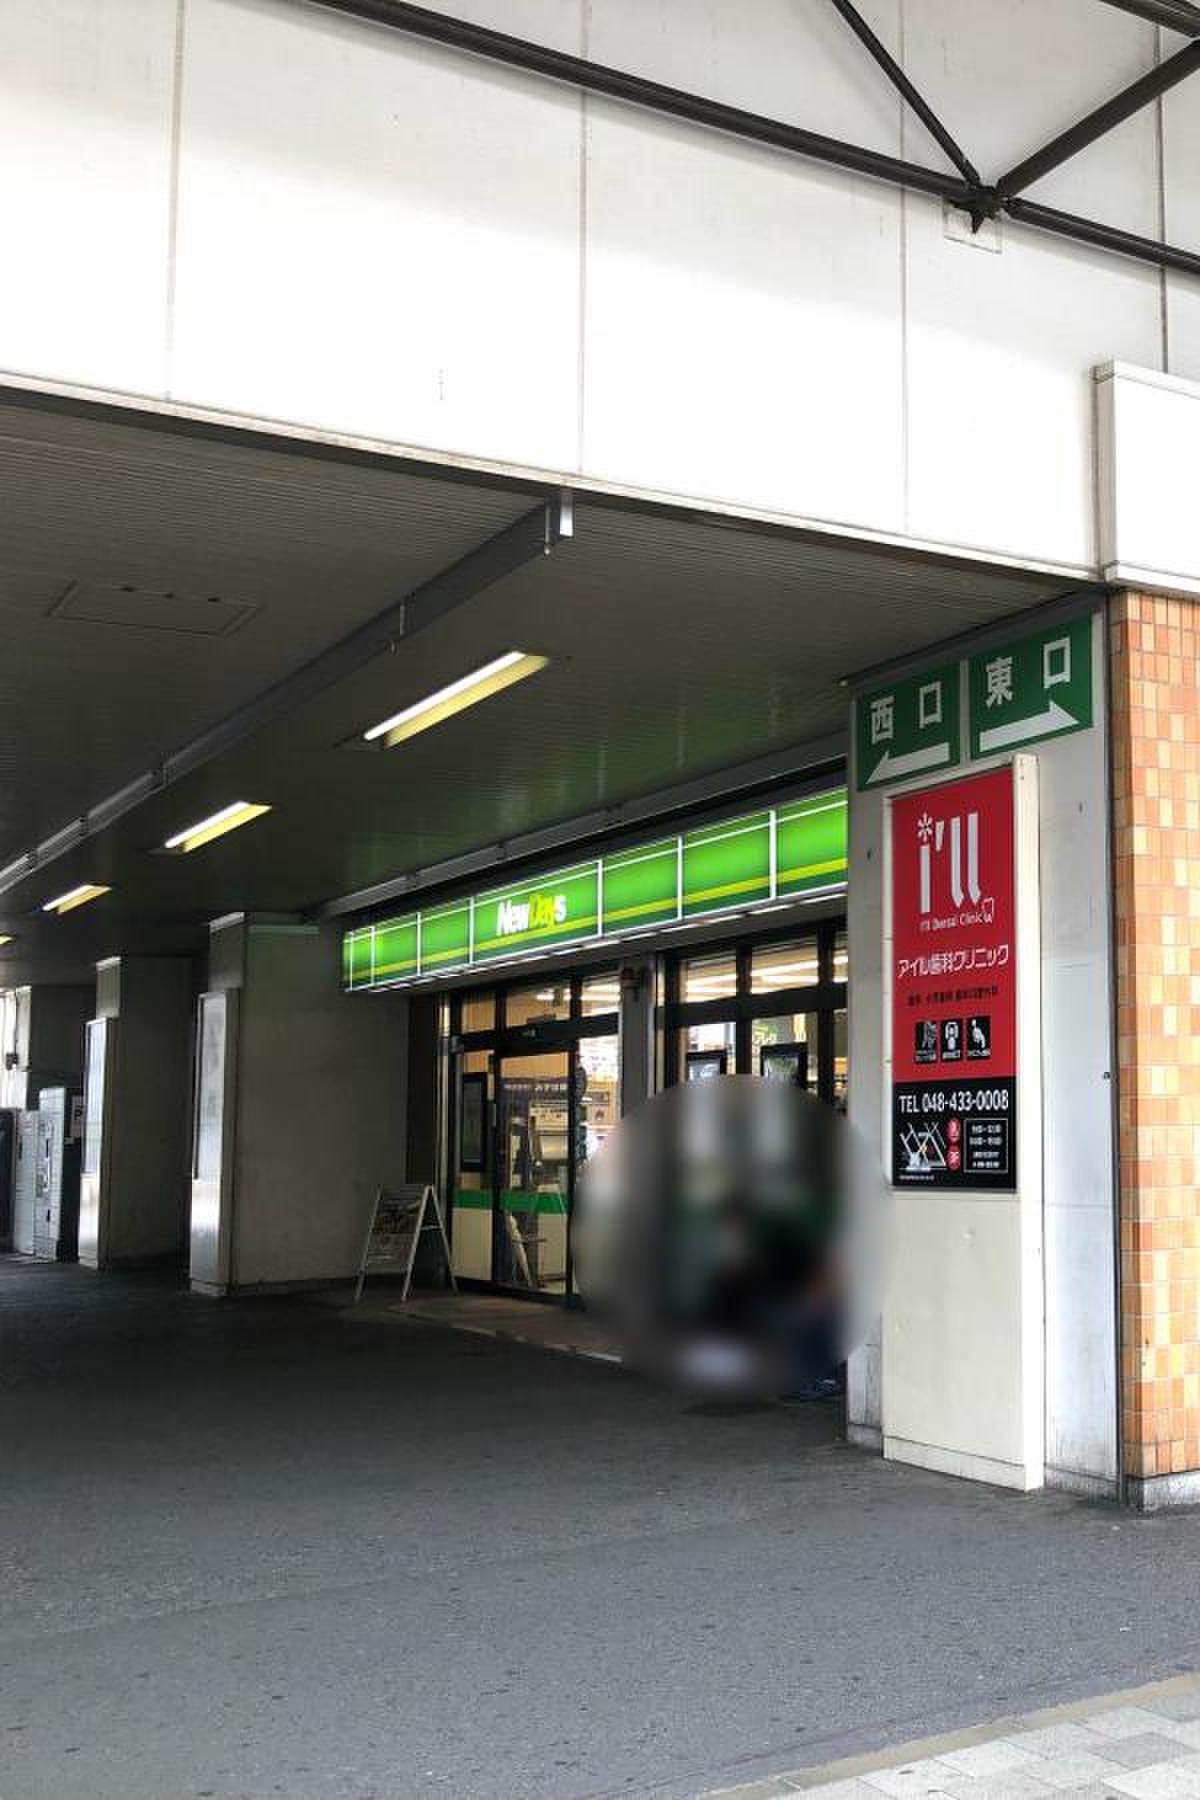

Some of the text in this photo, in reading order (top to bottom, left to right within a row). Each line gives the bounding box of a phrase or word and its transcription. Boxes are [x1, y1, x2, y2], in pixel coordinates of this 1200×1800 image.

[986, 637, 1071, 709] 東口
[871, 681, 943, 745] 西口
[898, 944, 1009, 978] アイル歯科クリニック
[899, 1090, 1009, 1113] TEL 048-433-0008
